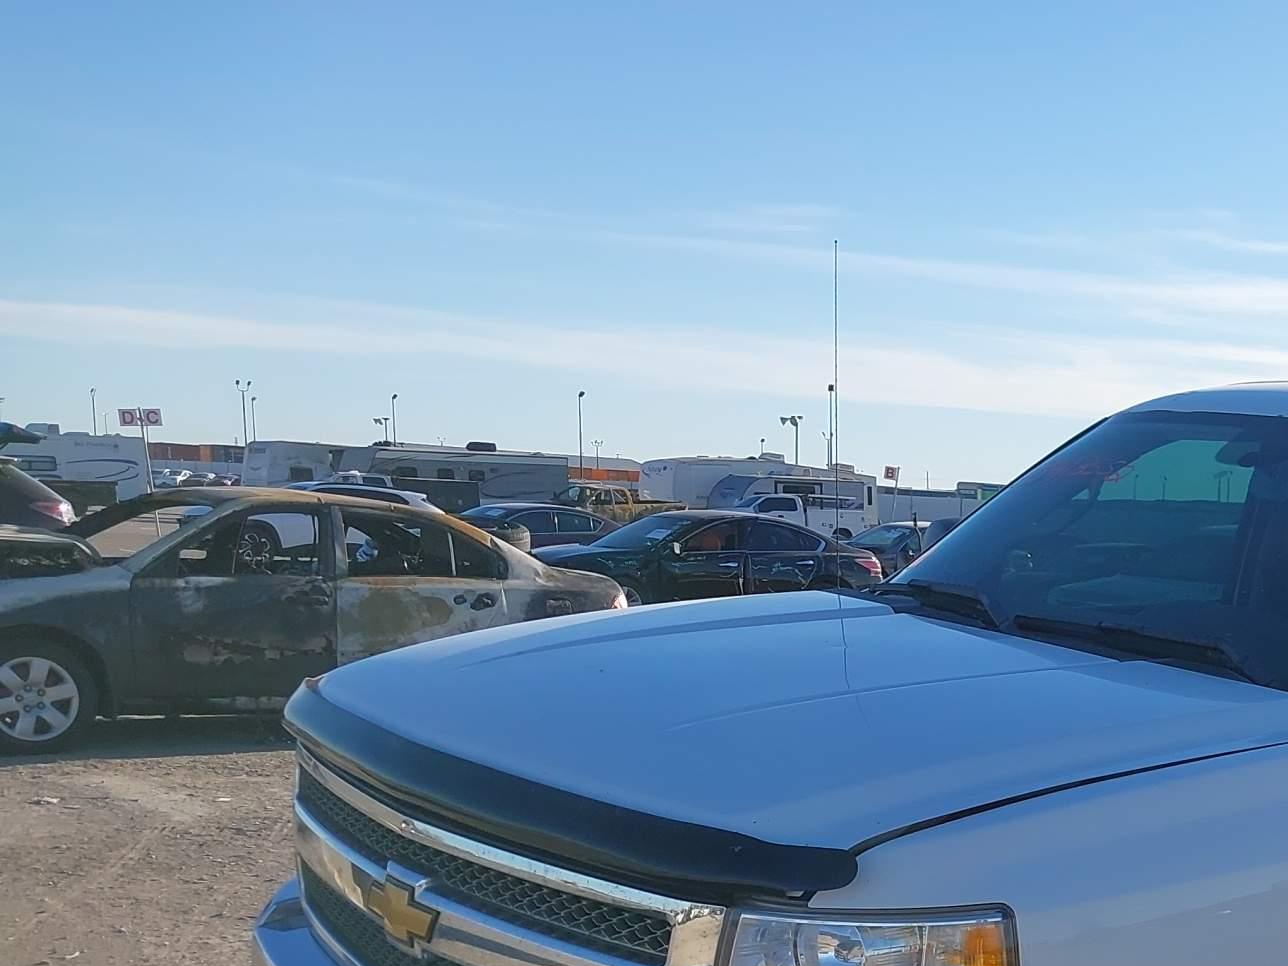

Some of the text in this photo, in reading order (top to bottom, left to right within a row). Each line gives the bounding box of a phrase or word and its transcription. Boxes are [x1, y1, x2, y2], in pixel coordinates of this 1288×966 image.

[121, 410, 159, 425] D C
[887, 467, 895, 478] B
